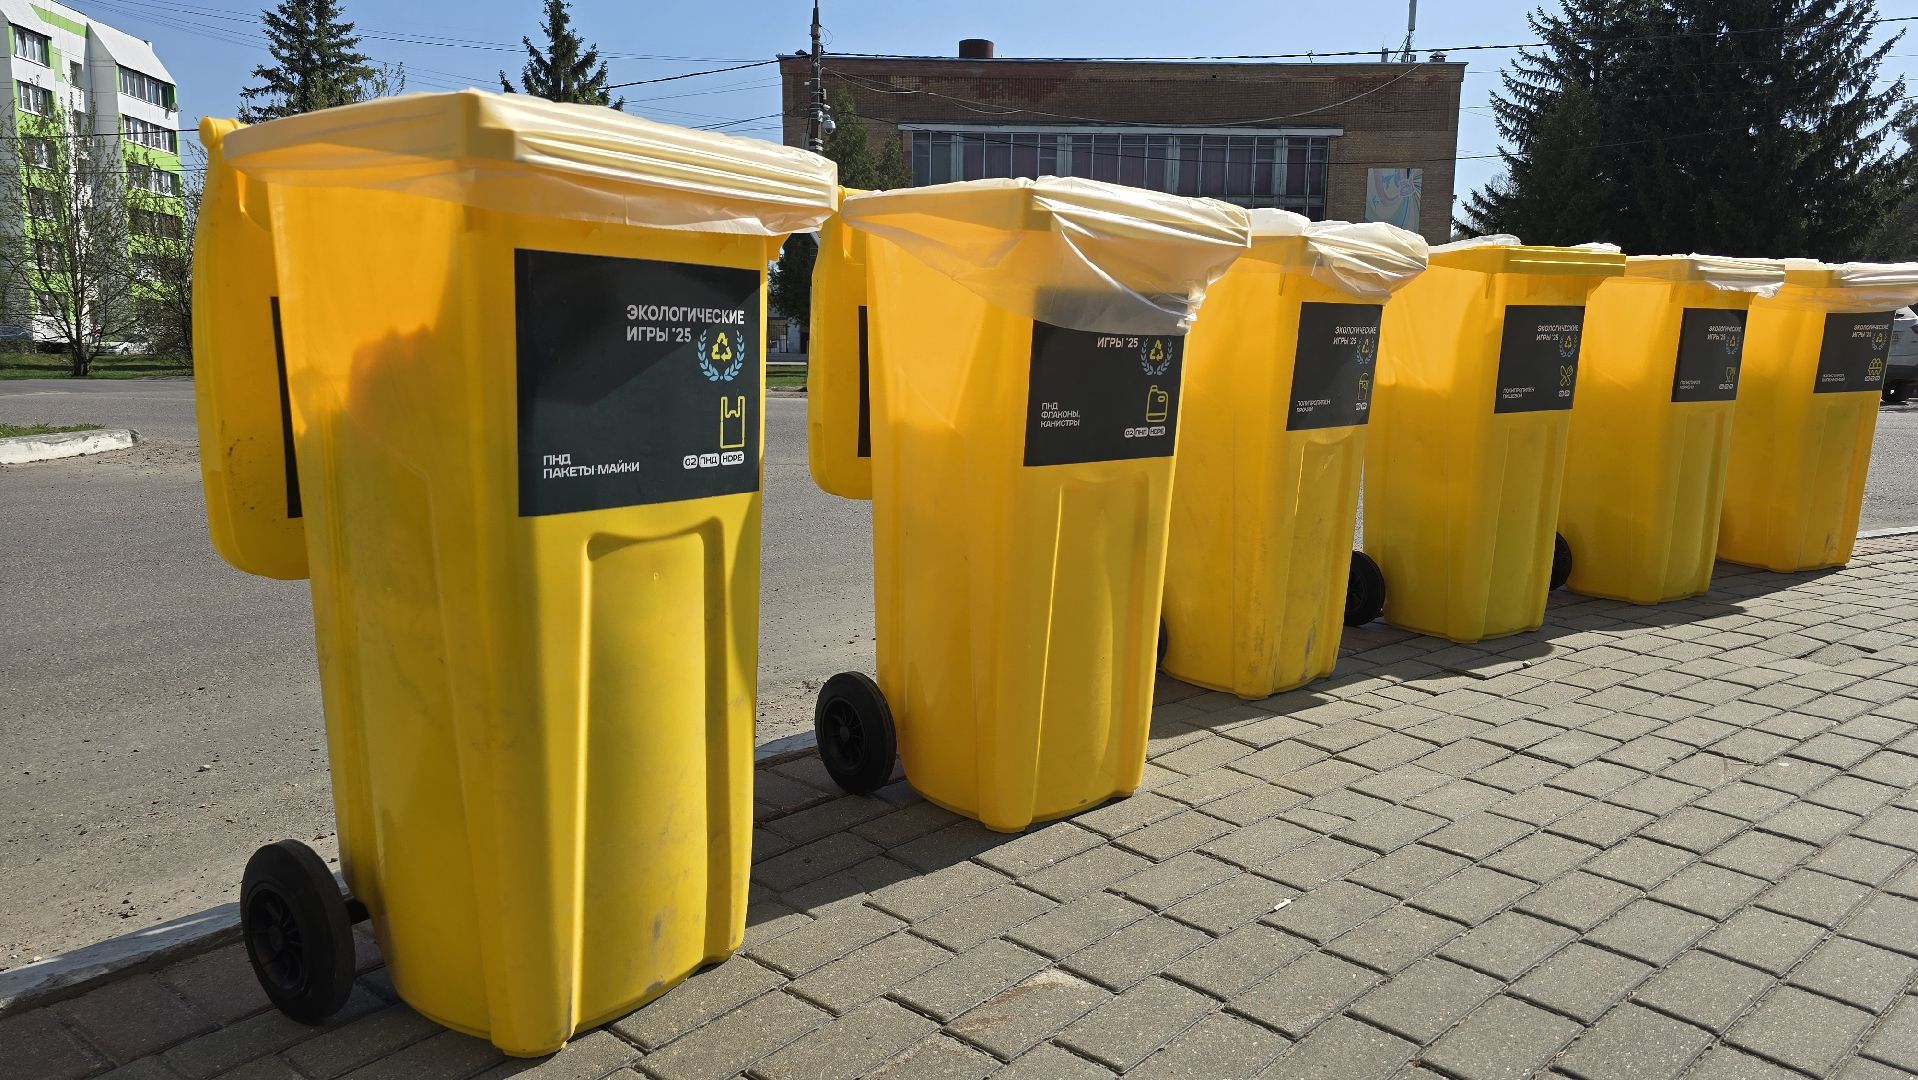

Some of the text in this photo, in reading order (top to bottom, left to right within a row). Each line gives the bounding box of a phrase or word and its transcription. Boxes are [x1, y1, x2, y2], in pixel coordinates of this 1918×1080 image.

[626, 304, 745, 325] ЭКОЛОГИЧЕСКИЕ
[626, 325, 692, 343] ИГРЫ '25
[1334, 326, 1377, 334] ЭКОЛОГИЧЕСКИЕ
[1097, 337, 1139, 348] ИГРЫ '25
[1332, 336, 1349, 345] ИГРЫ
[1041, 402, 1058, 411] ПНД
[1041, 410, 1080, 419] ФЛАКОНЫ,
[1040, 419, 1080, 428] КАНИСТРЫ
[543, 453, 571, 466] ПНД
[684, 453, 743, 467] 02 ПНД HDPE
[543, 460, 640, 479] ПАКЕТЫ-МАЙКИ
